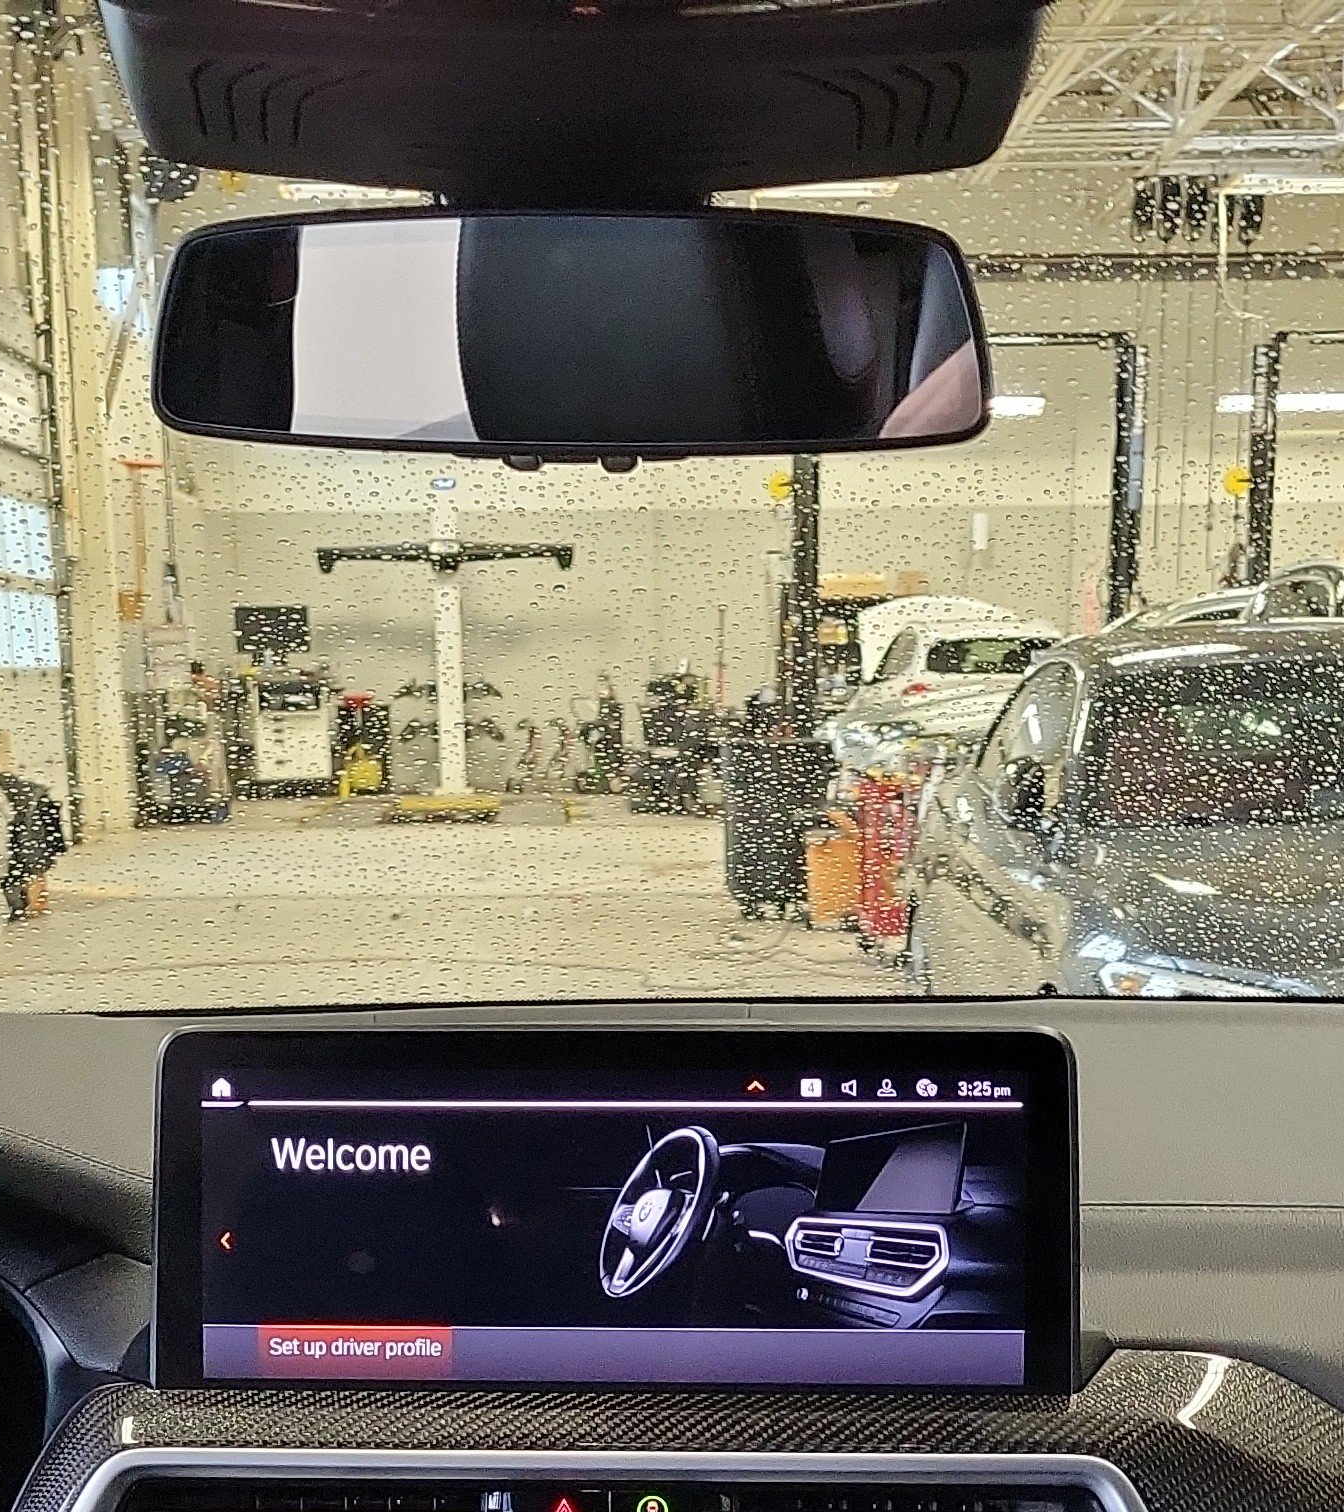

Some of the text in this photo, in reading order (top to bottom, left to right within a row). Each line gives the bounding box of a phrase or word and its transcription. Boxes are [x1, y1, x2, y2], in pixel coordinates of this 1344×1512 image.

[957, 1080, 1011, 1099] 3:25 pm
[270, 1137, 432, 1171] Welcome
[269, 1337, 443, 1360] Set up driver profile
